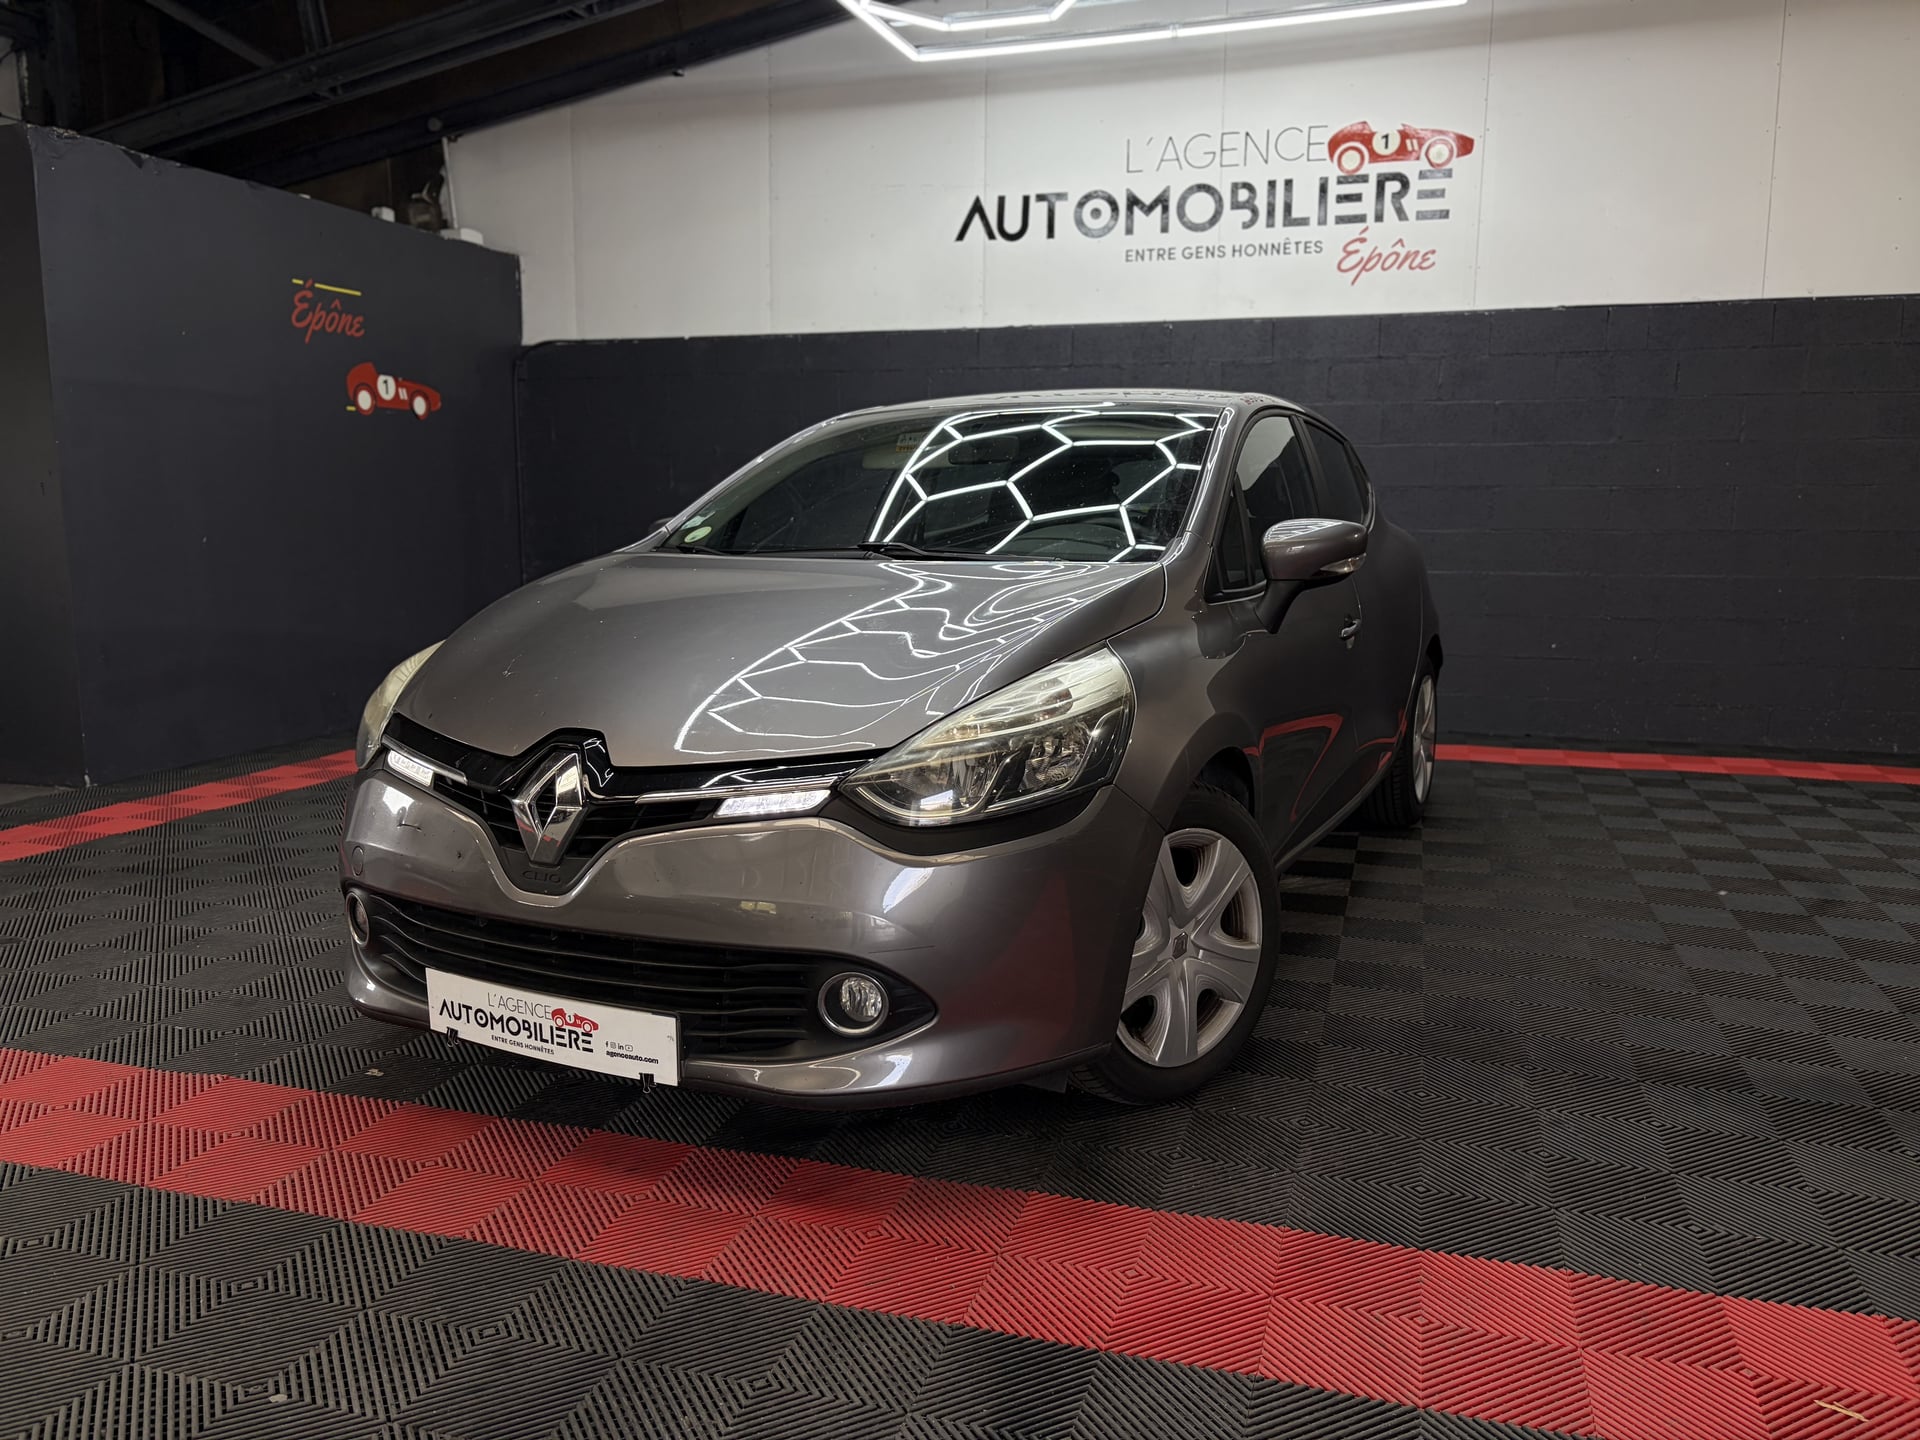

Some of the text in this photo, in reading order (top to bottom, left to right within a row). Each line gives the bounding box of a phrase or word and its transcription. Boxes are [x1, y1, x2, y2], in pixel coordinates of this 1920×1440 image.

[1126, 125, 1328, 173] L'AGENCE
[1125, 237, 1324, 263] ENTRE GENS HONNÊTES
[1337, 226, 1436, 286] Épône
[291, 278, 365, 344] Épône
[522, 870, 561, 883] CLIO
[487, 992, 552, 1021] L'AGENCE
[491, 1034, 555, 1055] ENTRE GENS HONNÊTES
[606, 1050, 659, 1065] agenceauto.com
